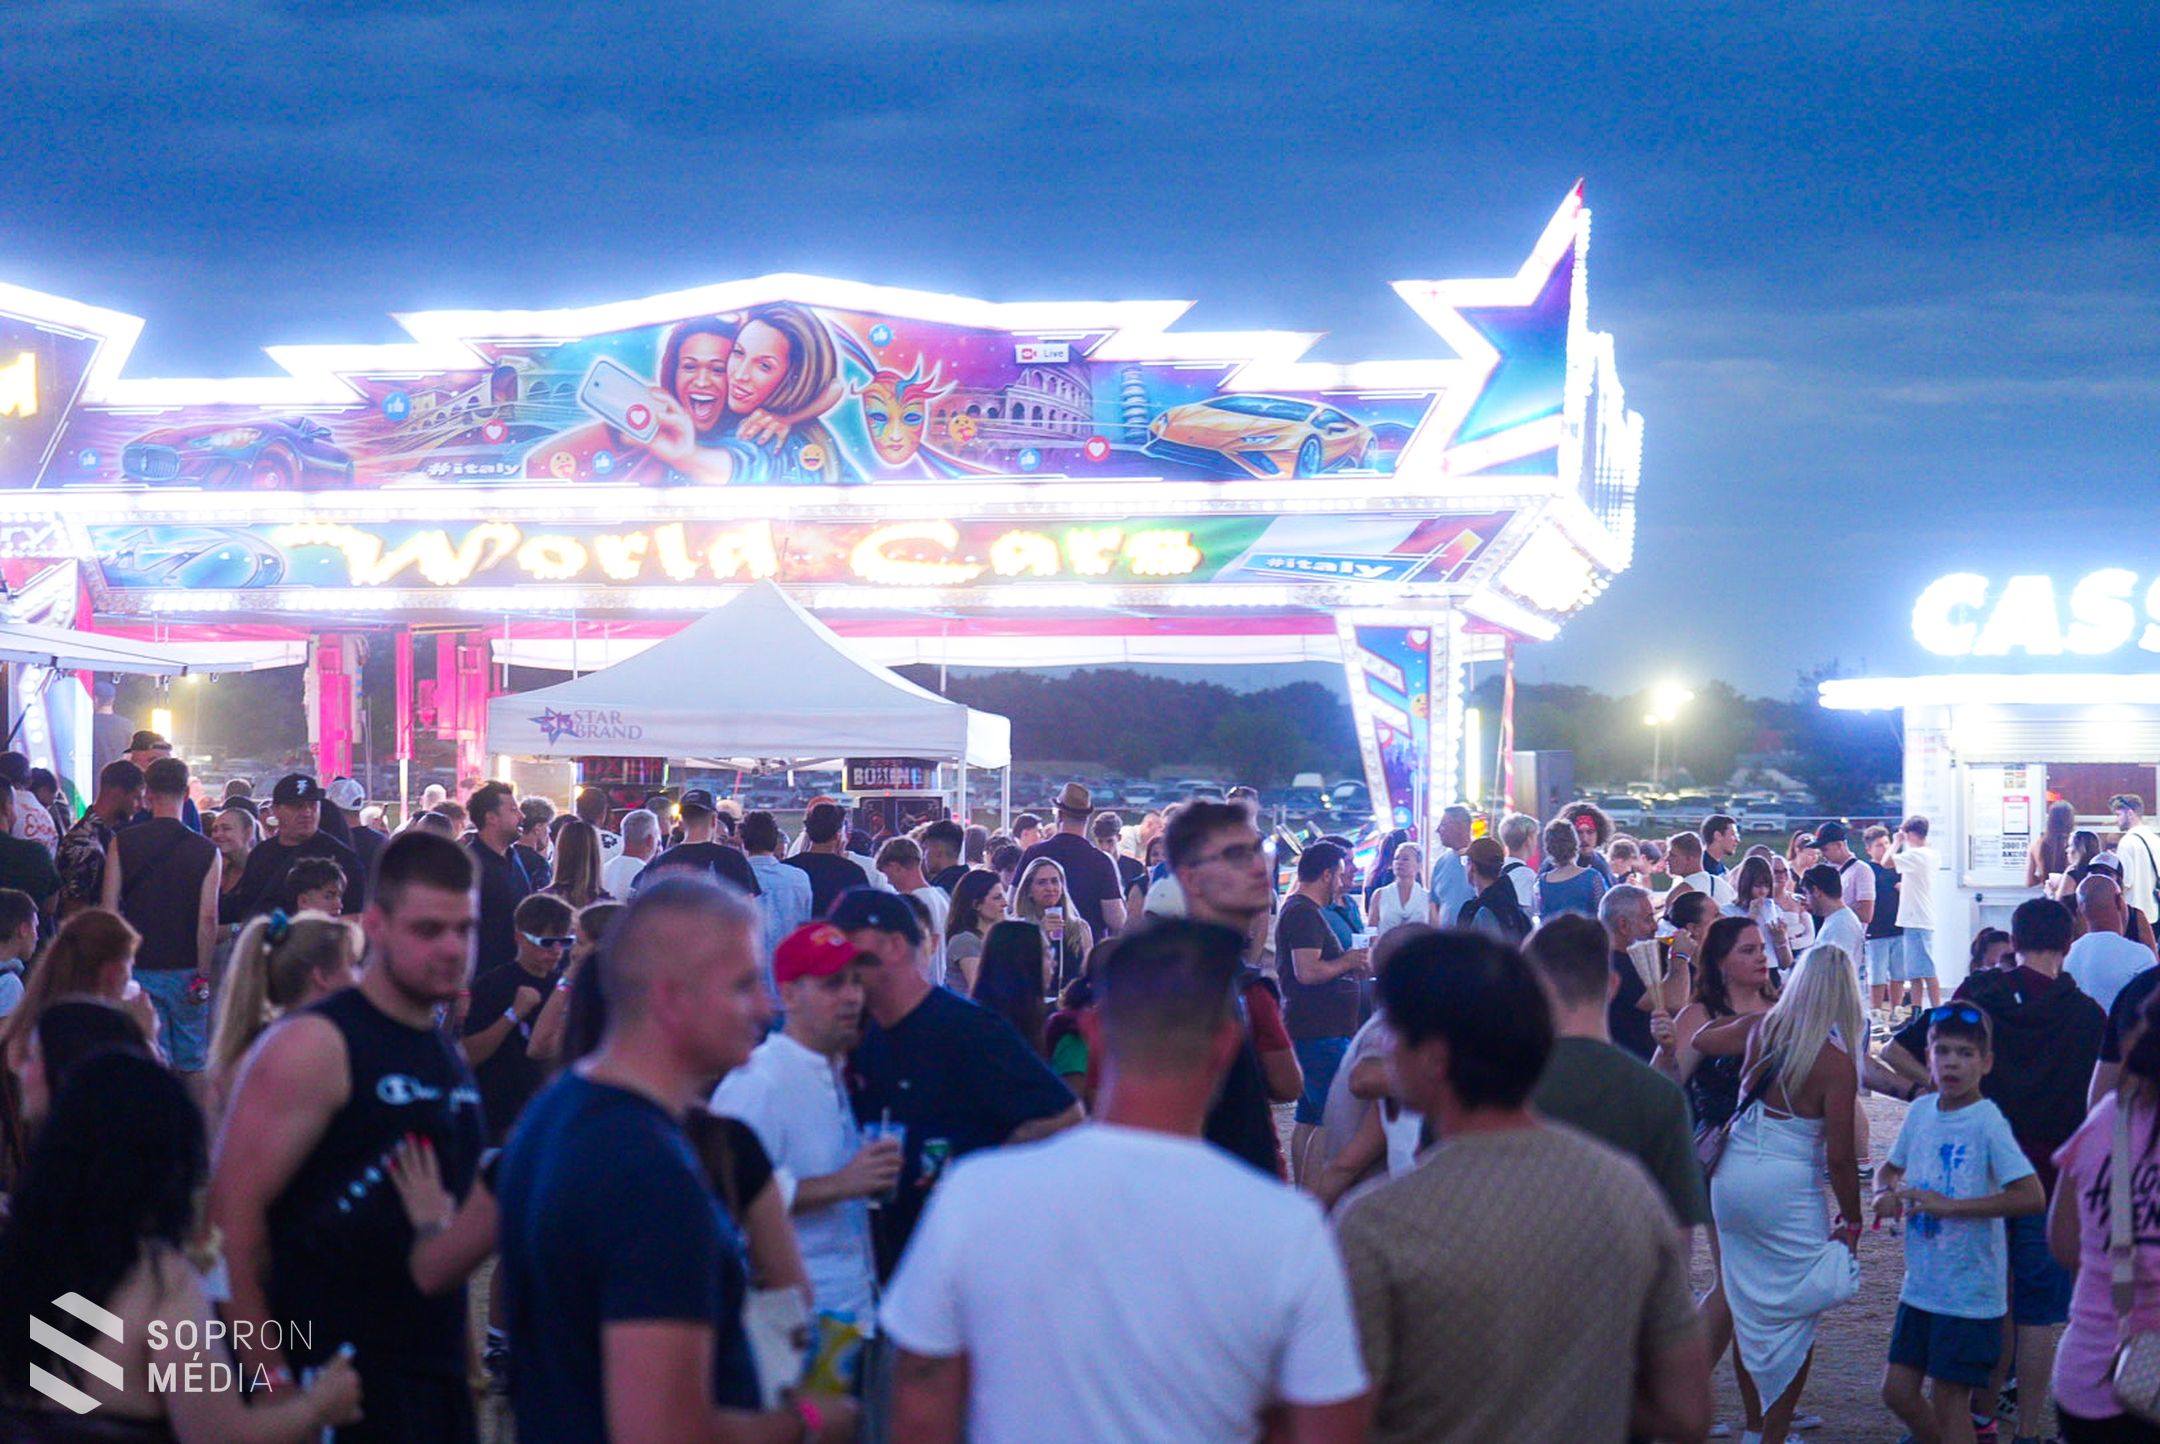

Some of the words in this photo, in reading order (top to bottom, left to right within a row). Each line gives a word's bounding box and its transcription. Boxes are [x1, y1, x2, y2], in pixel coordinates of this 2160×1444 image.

[1043, 349, 1064, 358] Live
[427, 462, 520, 476] #italy
[271, 523, 778, 586] World
[850, 520, 1203, 586] Cars
[1266, 558, 1393, 578] #italy
[1911, 568, 2160, 656] CAS
[574, 710, 623, 725] STAR
[576, 724, 642, 740] BRAND
